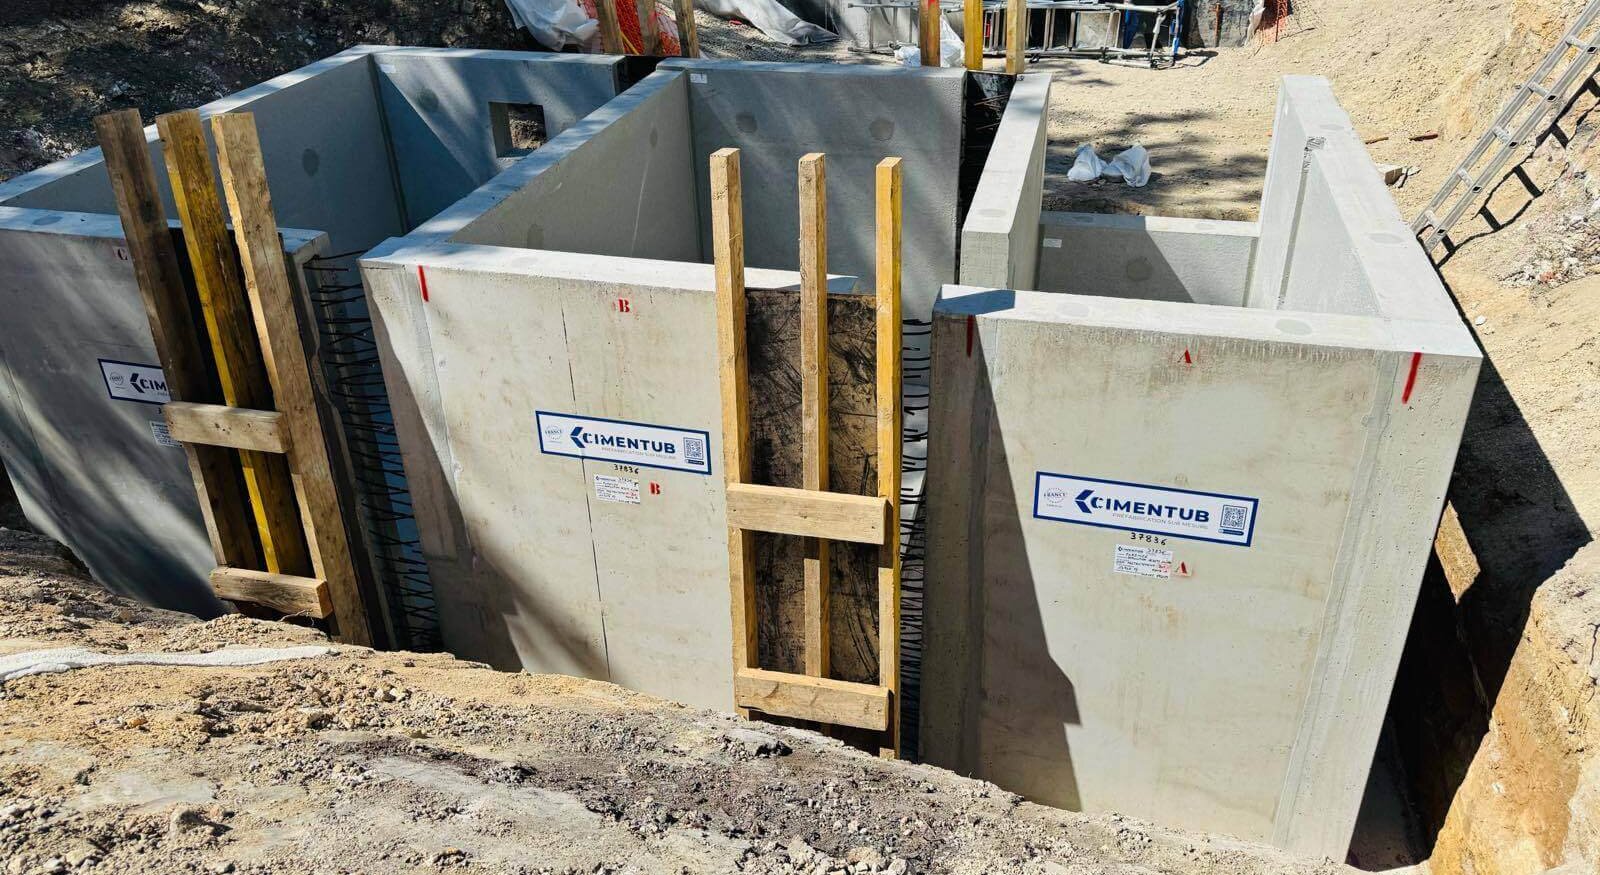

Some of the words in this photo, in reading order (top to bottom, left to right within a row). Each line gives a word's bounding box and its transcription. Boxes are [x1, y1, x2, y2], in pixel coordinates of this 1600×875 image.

[117, 248, 128, 260] C
[618, 298, 630, 313] B
[1177, 348, 1192, 364] A
[582, 432, 676, 454] CIMENTUB
[613, 463, 639, 475] 37836
[650, 482, 661, 495] B
[1090, 496, 1210, 523] CIMENTUB
[1130, 532, 1167, 546] 37836
[1174, 561, 1188, 574] A
